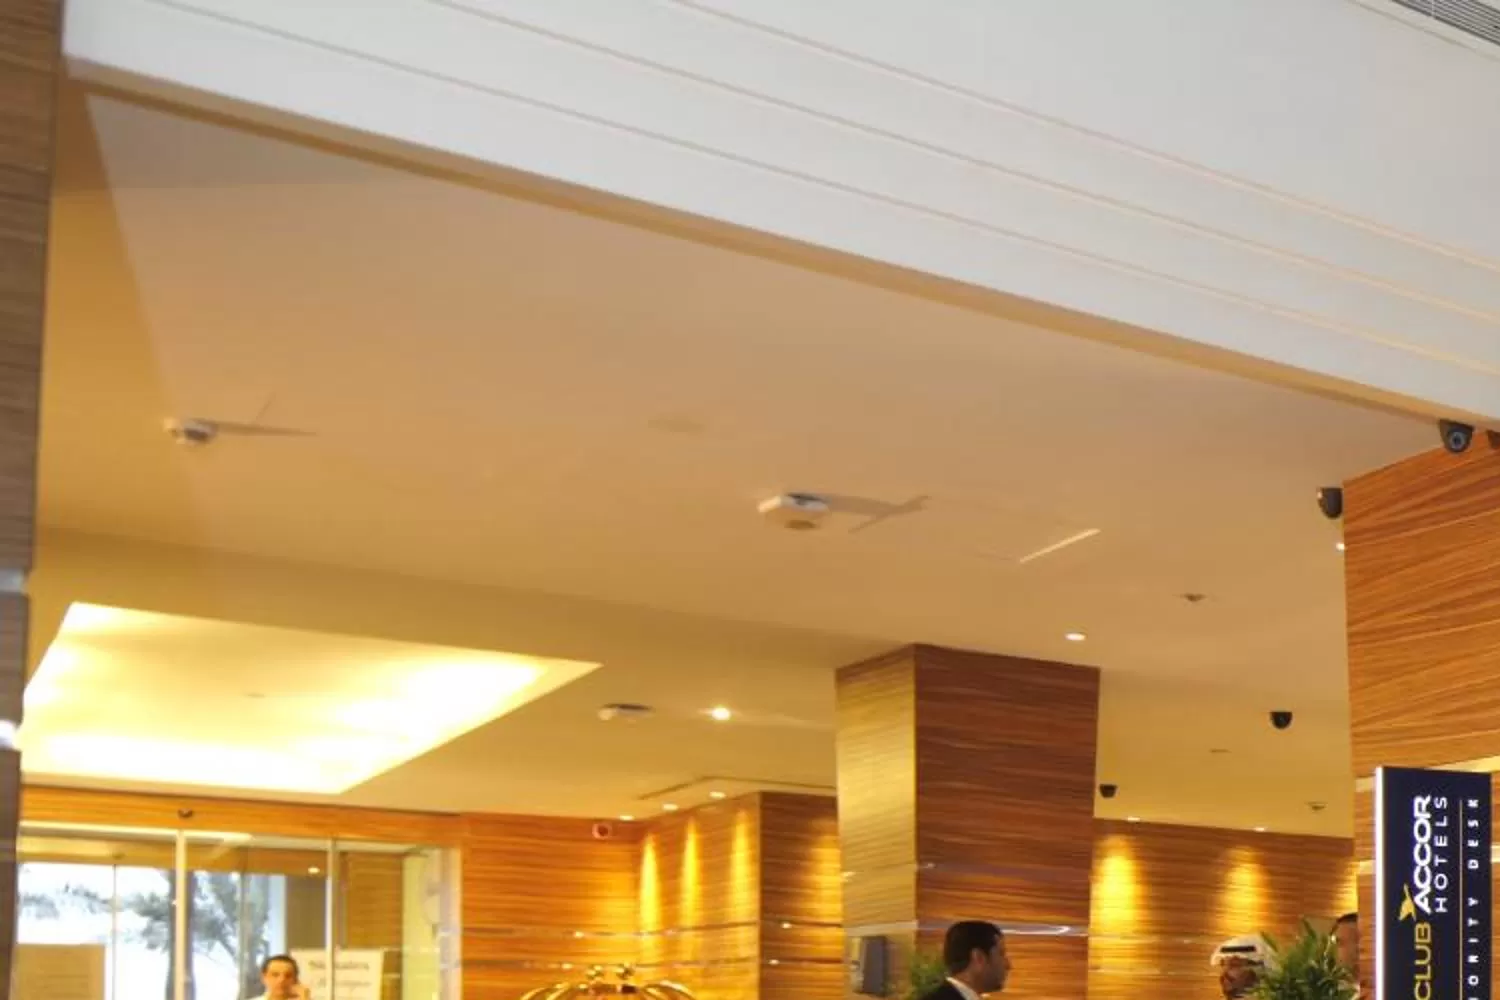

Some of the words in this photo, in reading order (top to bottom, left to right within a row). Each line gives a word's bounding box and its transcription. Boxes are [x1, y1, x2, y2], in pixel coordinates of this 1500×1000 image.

[1413, 794, 1433, 916] ACCOR
[1433, 796, 1449, 913] HOTELS
[1467, 798, 1479, 870] DESK
